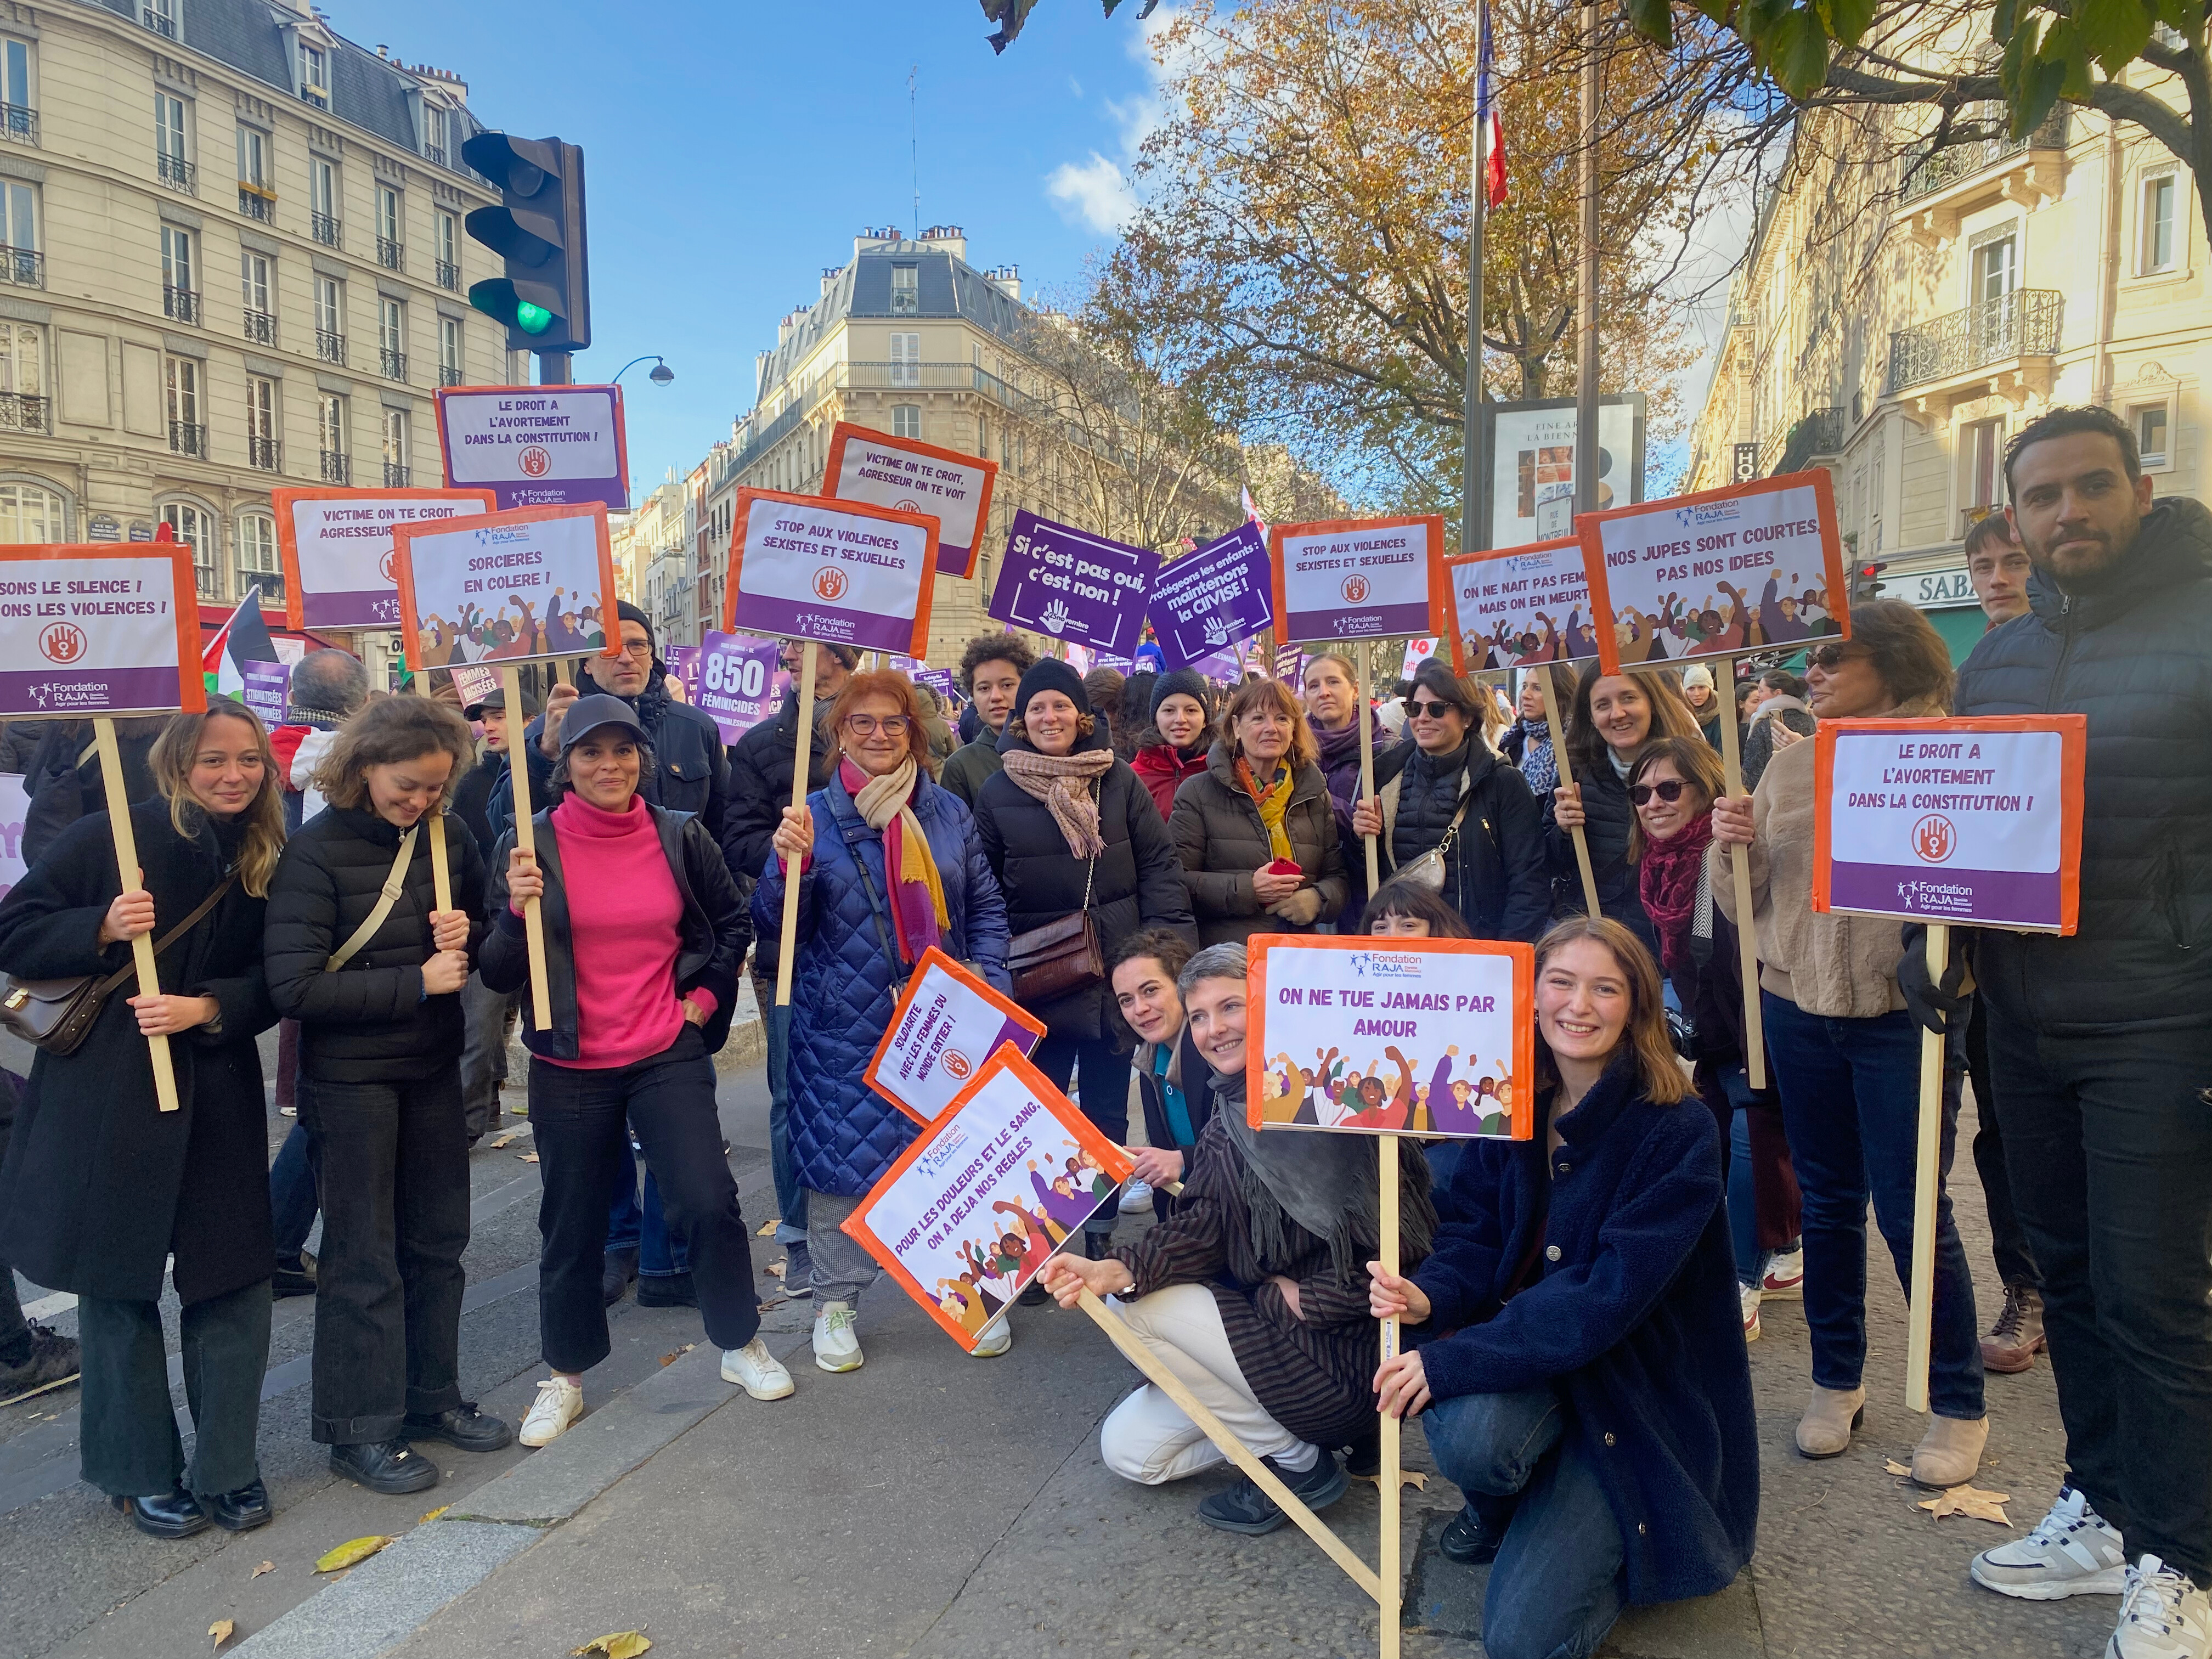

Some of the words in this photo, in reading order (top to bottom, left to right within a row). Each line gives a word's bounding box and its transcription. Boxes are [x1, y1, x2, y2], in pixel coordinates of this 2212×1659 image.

[499, 401, 512, 410] LE
[516, 400, 546, 410] DROIT
[551, 400, 558, 410] A
[489, 416, 570, 427] L'AVORTEMENT
[1536, 422, 1561, 431] FINE
[465, 435, 494, 444] DANS
[498, 434, 512, 444] LA
[516, 432, 590, 443] CONSTITUTION
[594, 432, 598, 441] !
[866, 452, 902, 469] VICTIME
[905, 461, 918, 473] ON
[921, 465, 933, 476] TE
[935, 469, 964, 486] CROIT,
[858, 467, 912, 488] AGRESSEUR
[915, 480, 928, 492] ON
[931, 483, 943, 495] TE
[946, 487, 966, 500] VOIT
[323, 510, 373, 521] VICTIME
[378, 509, 394, 519] ON
[399, 509, 415, 518] TE
[1695, 500, 1739, 513] Fondation
[1696, 510, 1724, 521] RAJA
[320, 526, 393, 538] AGRESSEUR
[491, 524, 528, 533] Fondation
[1551, 520, 1557, 528] DE
[775, 520, 805, 533] STOP
[808, 525, 833, 539] AUX
[837, 529, 899, 550] VIOLENCES
[763, 536, 818, 554] SEXISTES
[821, 545, 837, 558] ET
[840, 549, 905, 570] SEXUELLES
[1302, 545, 1326, 556] STOP
[1330, 543, 1350, 554] AUX
[1353, 538, 1406, 552] VIOLENCES
[1607, 549, 1636, 567] NOS
[1643, 540, 1691, 562] JUPES
[1696, 532, 1737, 552] SONT
[469, 551, 543, 571] SORCIERES
[1013, 534, 1031, 555] Si
[1032, 544, 1074, 569] c'est
[1075, 560, 1111, 580] pas
[1114, 573, 1147, 594] oui,
[1296, 559, 1340, 572] SEXISTES
[1344, 557, 1356, 567] ET
[1359, 552, 1414, 566] SEXUELLES
[1520, 552, 1552, 561] Fondation
[1200, 564, 1215, 577] les
[1657, 565, 1688, 583] PAS
[1693, 558, 1724, 577] NOS
[1729, 550, 1775, 571] IDEES
[42, 582, 61, 594] LE
[67, 580, 130, 594] SILENCE
[136, 580, 142, 592] !
[464, 579, 483, 593] EN
[487, 572, 540, 590] COLERE
[545, 572, 550, 584] !
[1029, 566, 1071, 591] c'est
[1073, 581, 1110, 603] non
[1112, 588, 1121, 606] !
[1167, 562, 1249, 611] maintenons
[1464, 587, 1479, 599] ON
[1483, 584, 1498, 597] NE
[1502, 579, 1528, 594] NAIT
[1533, 575, 1557, 589] PAS
[1560, 571, 1587, 585] FEM
[37, 603, 66, 616] LES
[70, 601, 155, 615] VIOLENCES
[161, 601, 166, 613] !
[1177, 608, 1193, 623] la
[1193, 581, 1242, 614] CIIVISE
[1241, 577, 1249, 592] !
[1479, 601, 1506, 614] MAIS
[1510, 597, 1525, 610] ON
[1530, 595, 1545, 607] EN
[1549, 588, 1589, 604] MEURT
[814, 614, 855, 628] Fondation
[1348, 615, 1382, 623] Fondation
[813, 623, 839, 634] RAJA
[458, 667, 490, 686] FEMMES
[706, 652, 764, 697] 850
[53, 682, 108, 692] Fondation
[54, 692, 89, 701] RAJA
[702, 692, 761, 715] FÉMINICIDES
[1899, 744, 1915, 759] LE
[1919, 743, 1962, 759] DROIT
[1968, 743, 1980, 759] A
[1883, 768, 1995, 785] L'AVORTEMENT
[1848, 793, 1886, 808] DANS
[1890, 794, 1906, 809] LA
[1912, 794, 2021, 811] CONSTITUTION
[2027, 796, 2034, 811] !
[1920, 882, 1972, 895] Fondation
[1920, 893, 1953, 905] RAJA
[1373, 953, 1421, 963] Fondation
[1373, 963, 1403, 972] RAJA
[1279, 988, 1302, 1005] ON
[1309, 989, 1333, 1006] NE
[1339, 990, 1374, 1007] TUE
[1381, 992, 1449, 1011] JAMAIS
[1456, 995, 1494, 1012] PAR
[895, 1003, 922, 1051] SOLIDARITE
[1353, 1018, 1417, 1037] AMOUR
[899, 1056, 914, 1080] AVEC
[909, 1041, 922, 1059] LES
[916, 1006, 940, 1043] FEMMES
[934, 993, 947, 1009] DU
[916, 1052, 936, 1082] MONDE
[930, 1021, 952, 1054] ENTIER
[927, 1125, 960, 1158] Fondation
[933, 1142, 955, 1165] RAJA
[895, 1227, 921, 1257] POUR
[918, 1207, 939, 1231] LES
[936, 1158, 984, 1211] DOULEURS
[981, 1142, 997, 1163] ET
[995, 1128, 1012, 1147] LE
[1009, 1101, 1041, 1132] SANG,
[927, 1231, 945, 1250] ON
[943, 1222, 954, 1235] A
[950, 1195, 979, 1226] DEJA
[974, 1173, 997, 1199] NOS
[994, 1136, 1032, 1178] REGLES
